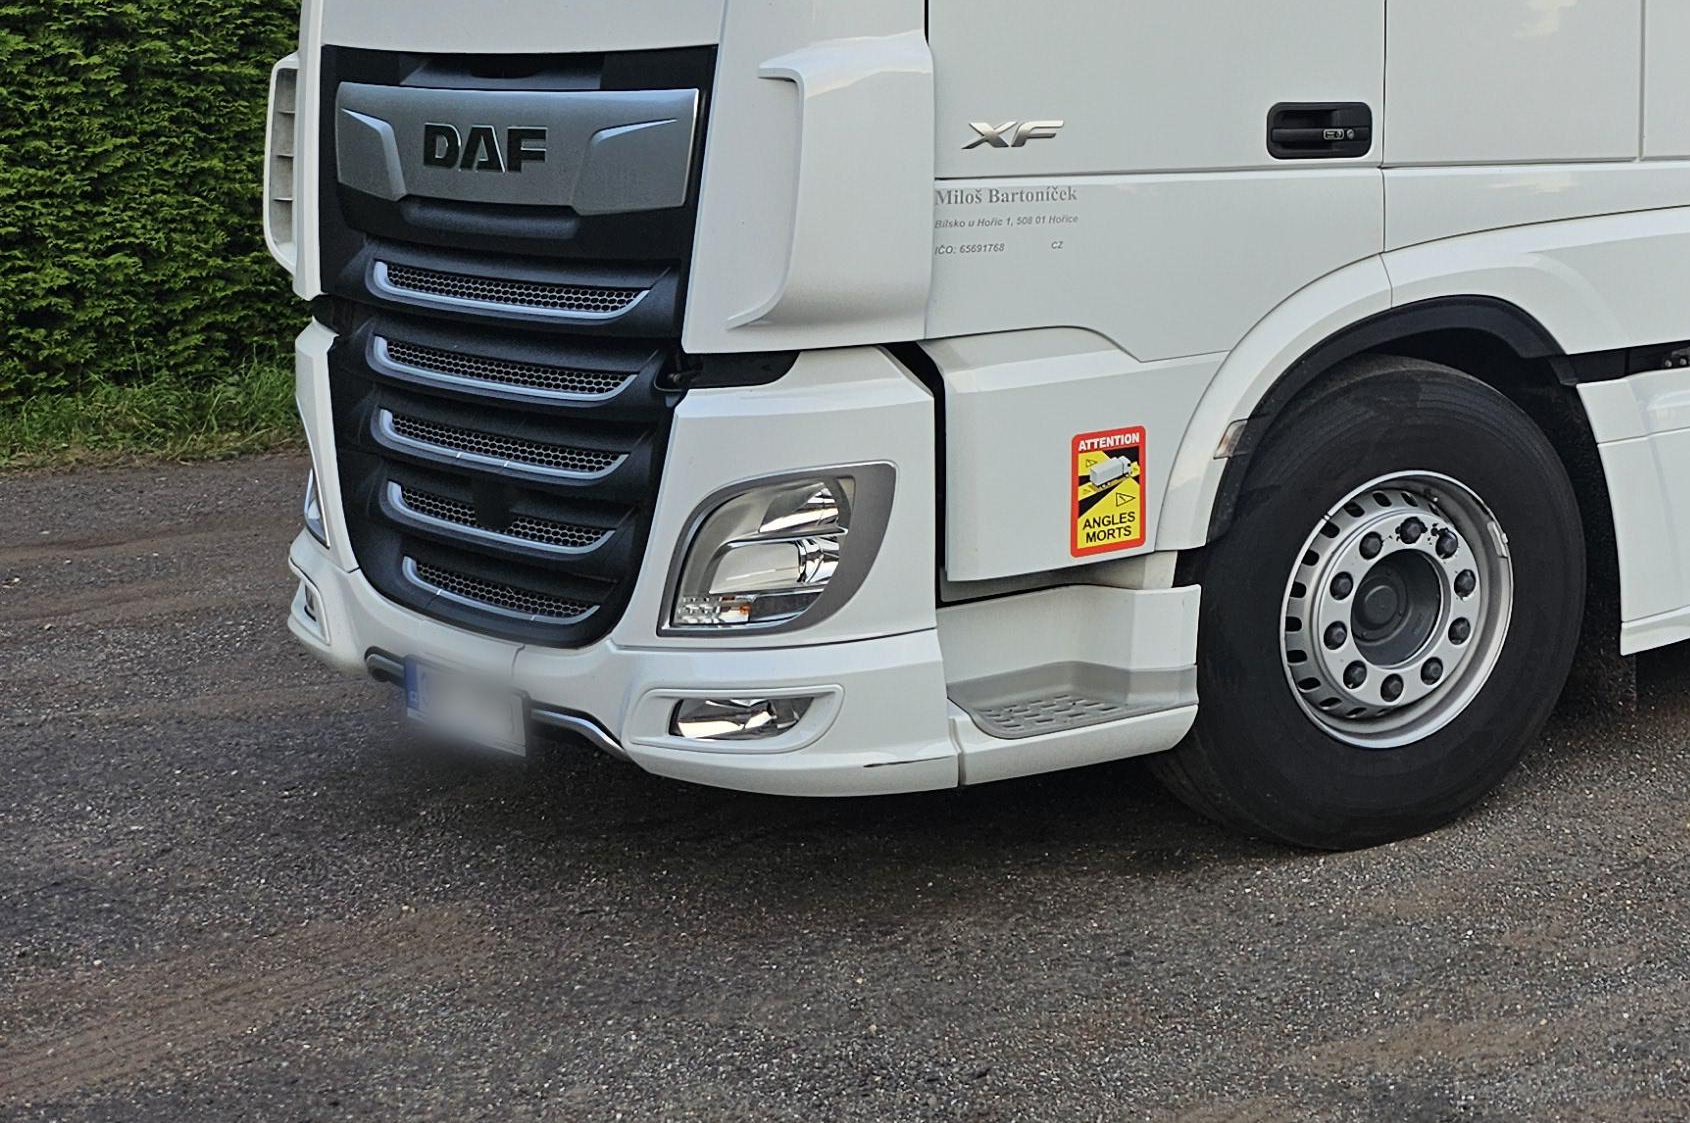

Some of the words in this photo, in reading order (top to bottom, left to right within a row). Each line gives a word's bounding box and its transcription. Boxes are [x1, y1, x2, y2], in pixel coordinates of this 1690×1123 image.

[962, 119, 1064, 150] XF
[423, 122, 548, 173] DAF
[935, 190, 983, 205] Miloš
[988, 186, 1078, 204] Bartoníček
[1035, 215, 1046, 224] 01
[934, 243, 957, 255] IČO:
[959, 243, 1006, 254] 65691768
[1078, 432, 1140, 452] ATTENTION
[1082, 511, 1136, 530] ANGLES
[1086, 525, 1132, 543] MORTS
